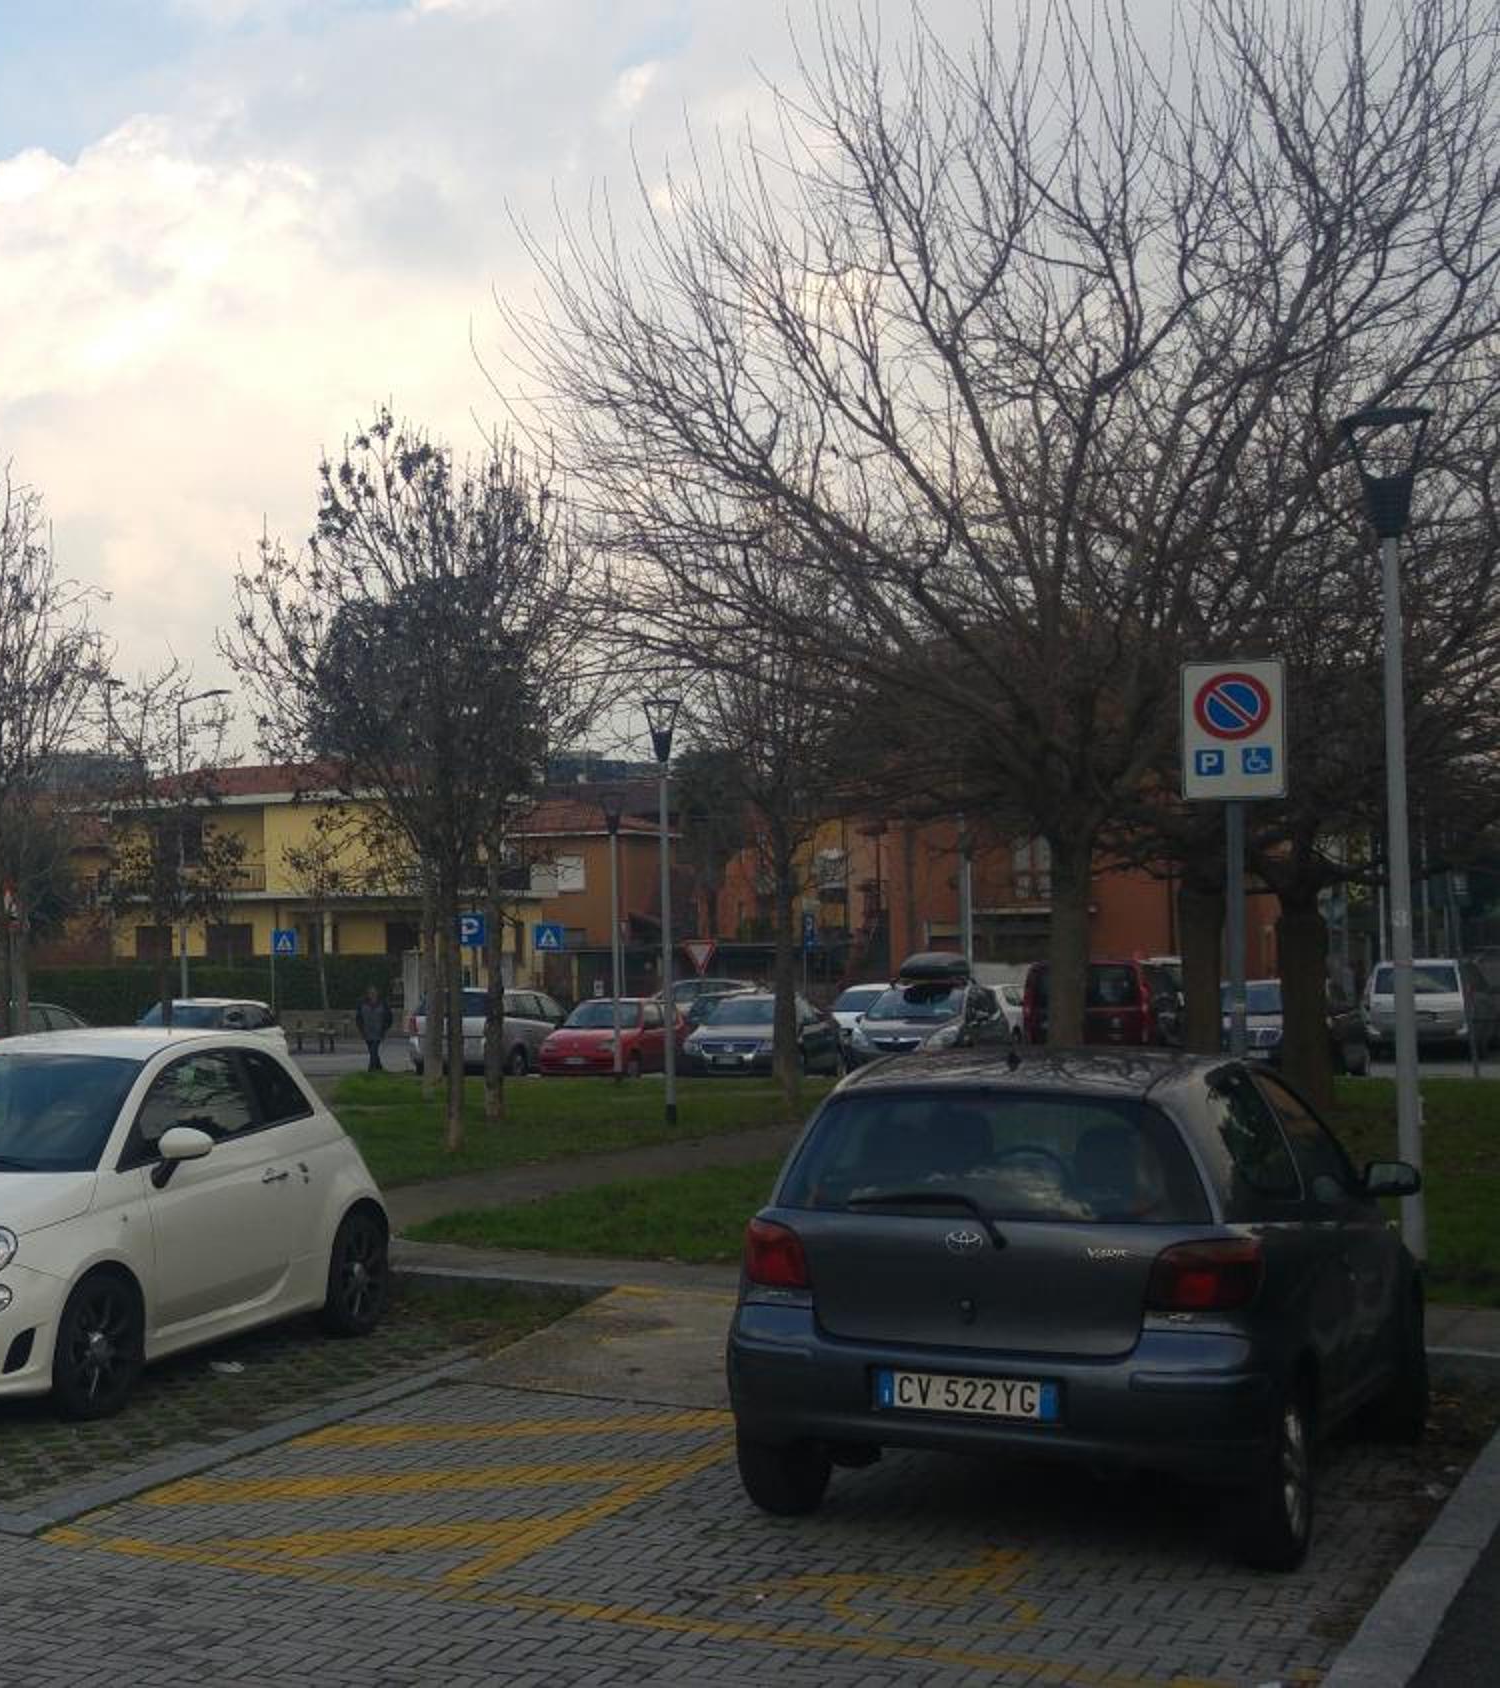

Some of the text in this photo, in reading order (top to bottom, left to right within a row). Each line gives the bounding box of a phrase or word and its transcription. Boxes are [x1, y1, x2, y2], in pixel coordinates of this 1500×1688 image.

[1201, 753, 1219, 773] P
[461, 917, 478, 942] P
[899, 1375, 1036, 1414] CV 522YG
